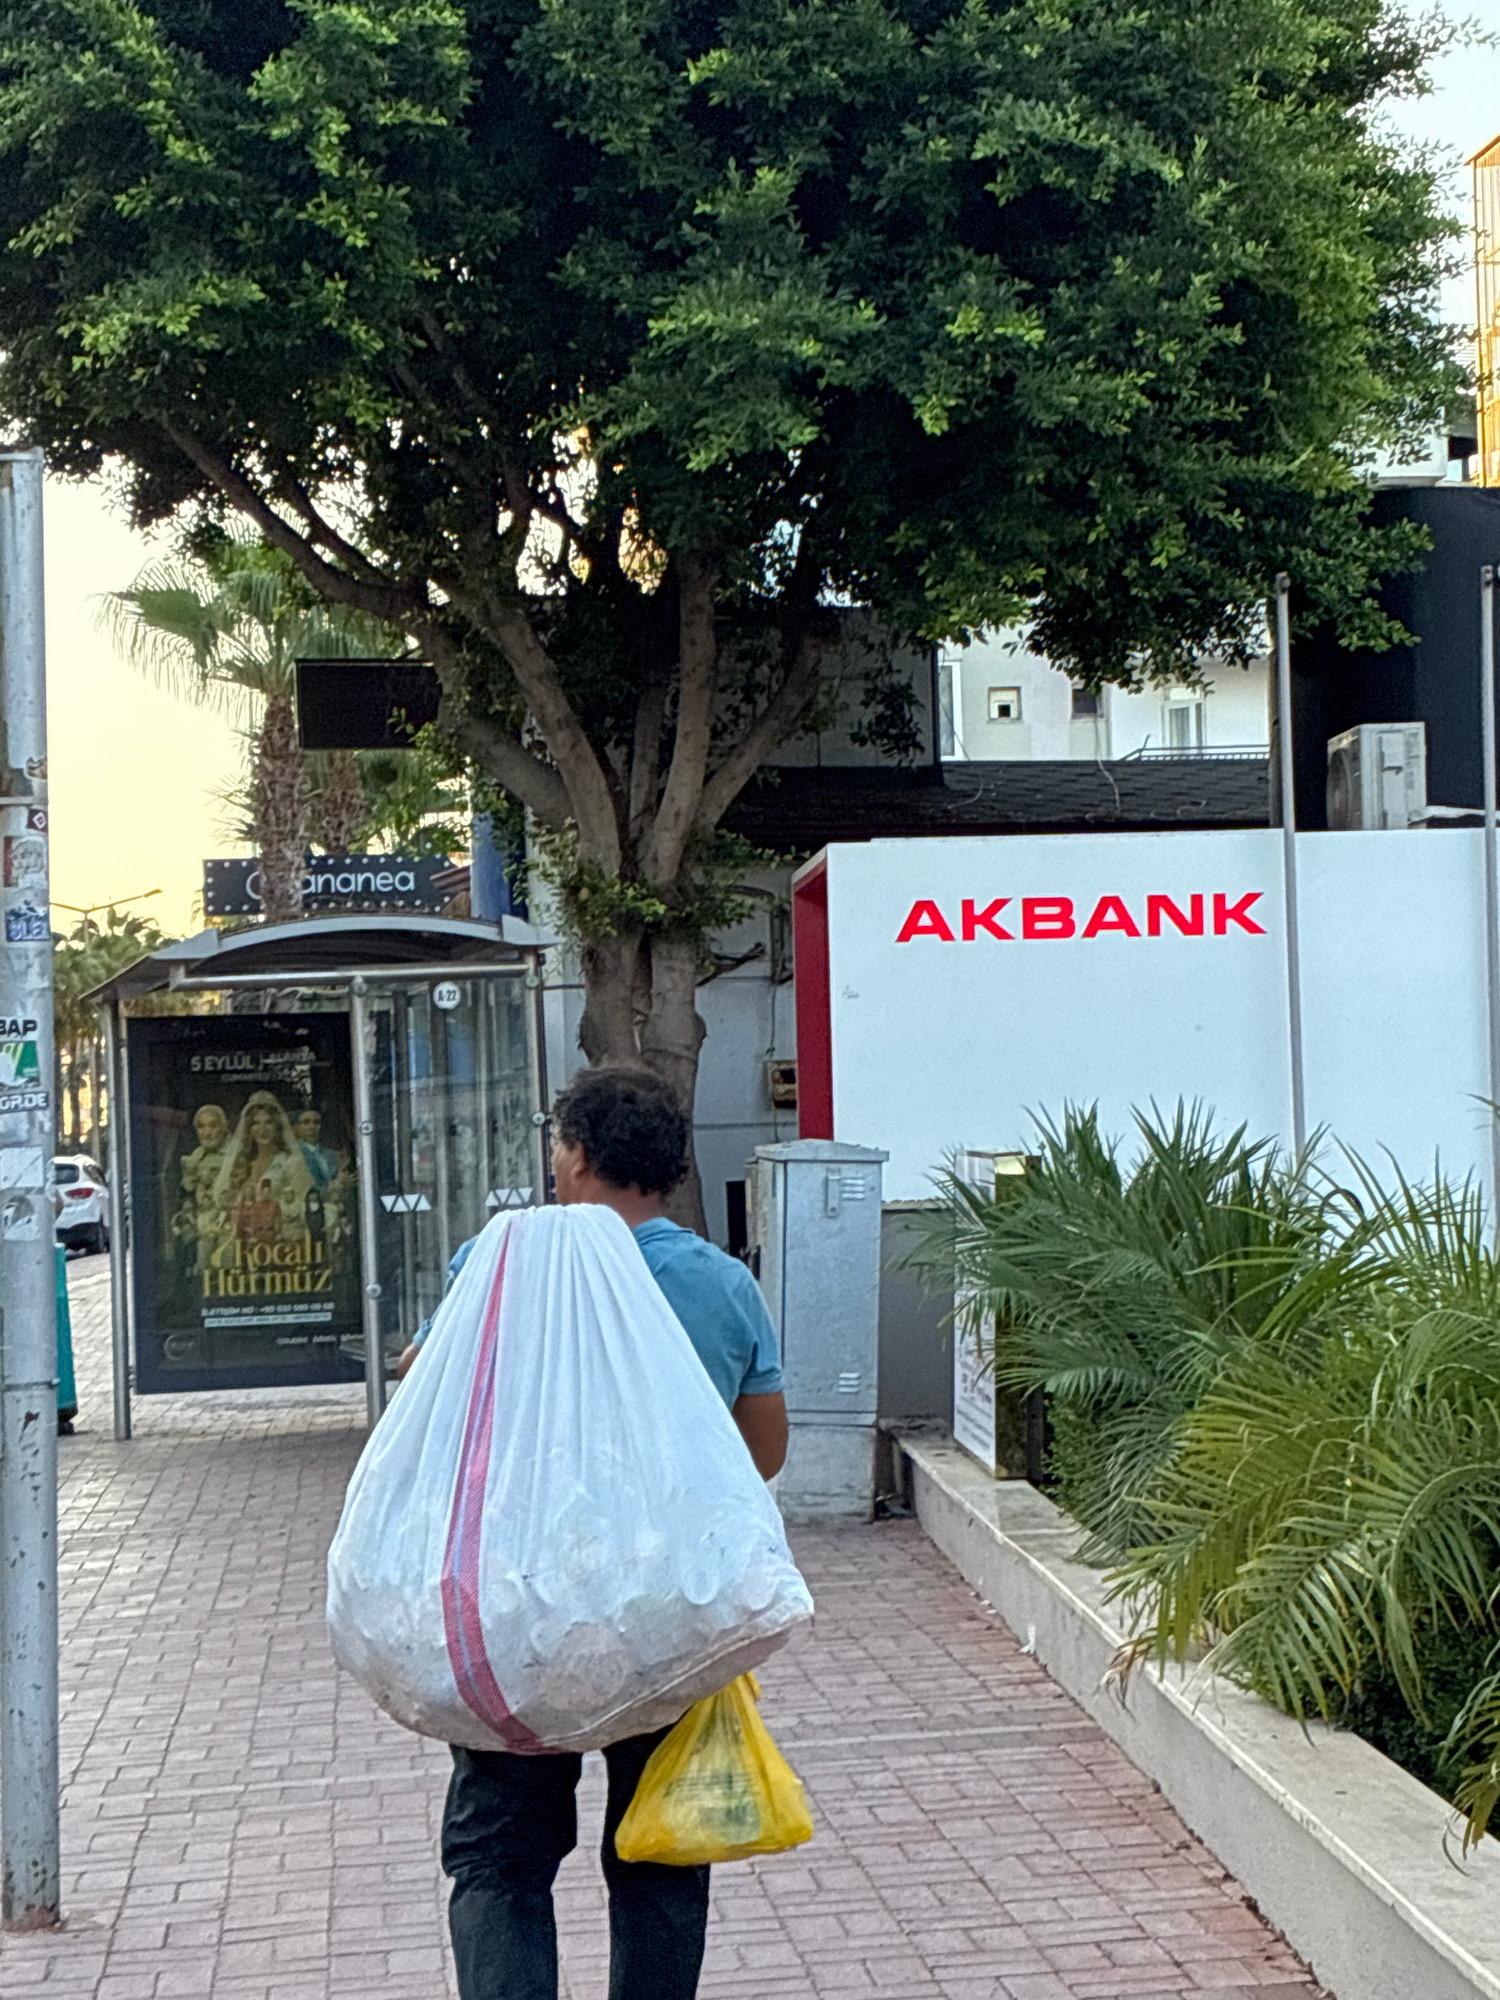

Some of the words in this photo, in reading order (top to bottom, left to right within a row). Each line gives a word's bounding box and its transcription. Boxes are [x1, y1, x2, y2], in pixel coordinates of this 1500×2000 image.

[894, 892, 1267, 943] AKBANK
[204, 1052, 255, 1071] EYLÜL
[203, 1266, 333, 1297] Hürmüz
